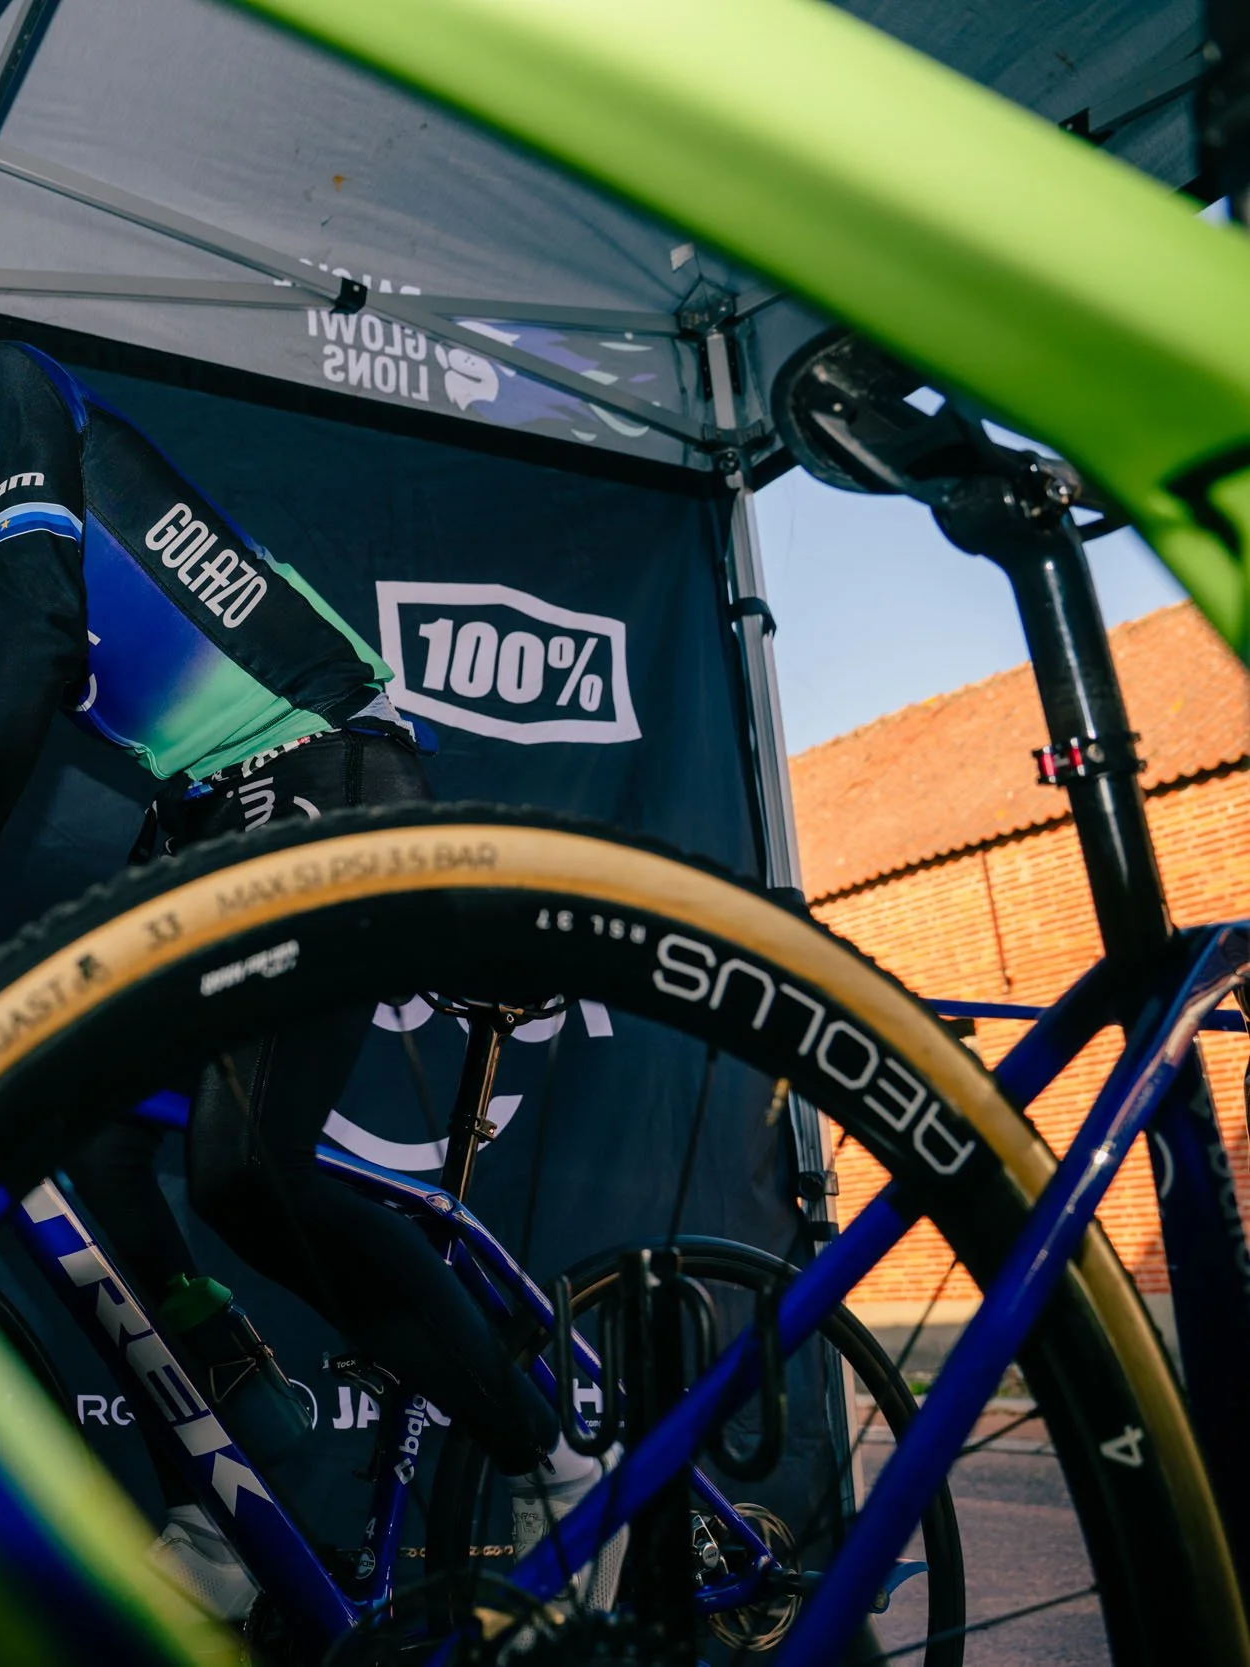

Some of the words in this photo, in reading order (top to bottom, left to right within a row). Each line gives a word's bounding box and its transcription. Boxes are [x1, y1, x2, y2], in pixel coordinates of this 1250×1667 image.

[144, 502, 268, 629] GOLAZO
[419, 618, 603, 712] 100%
[215, 873, 286, 917] MAX
[328, 852, 380, 884] PSI
[433, 841, 499, 871] BAR
[536, 907, 574, 932] 37
[590, 914, 647, 945] RSL
[654, 933, 975, 1175] AEOLUS
[21, 1177, 275, 1516] TREK
[364, 1516, 377, 1541] 4
